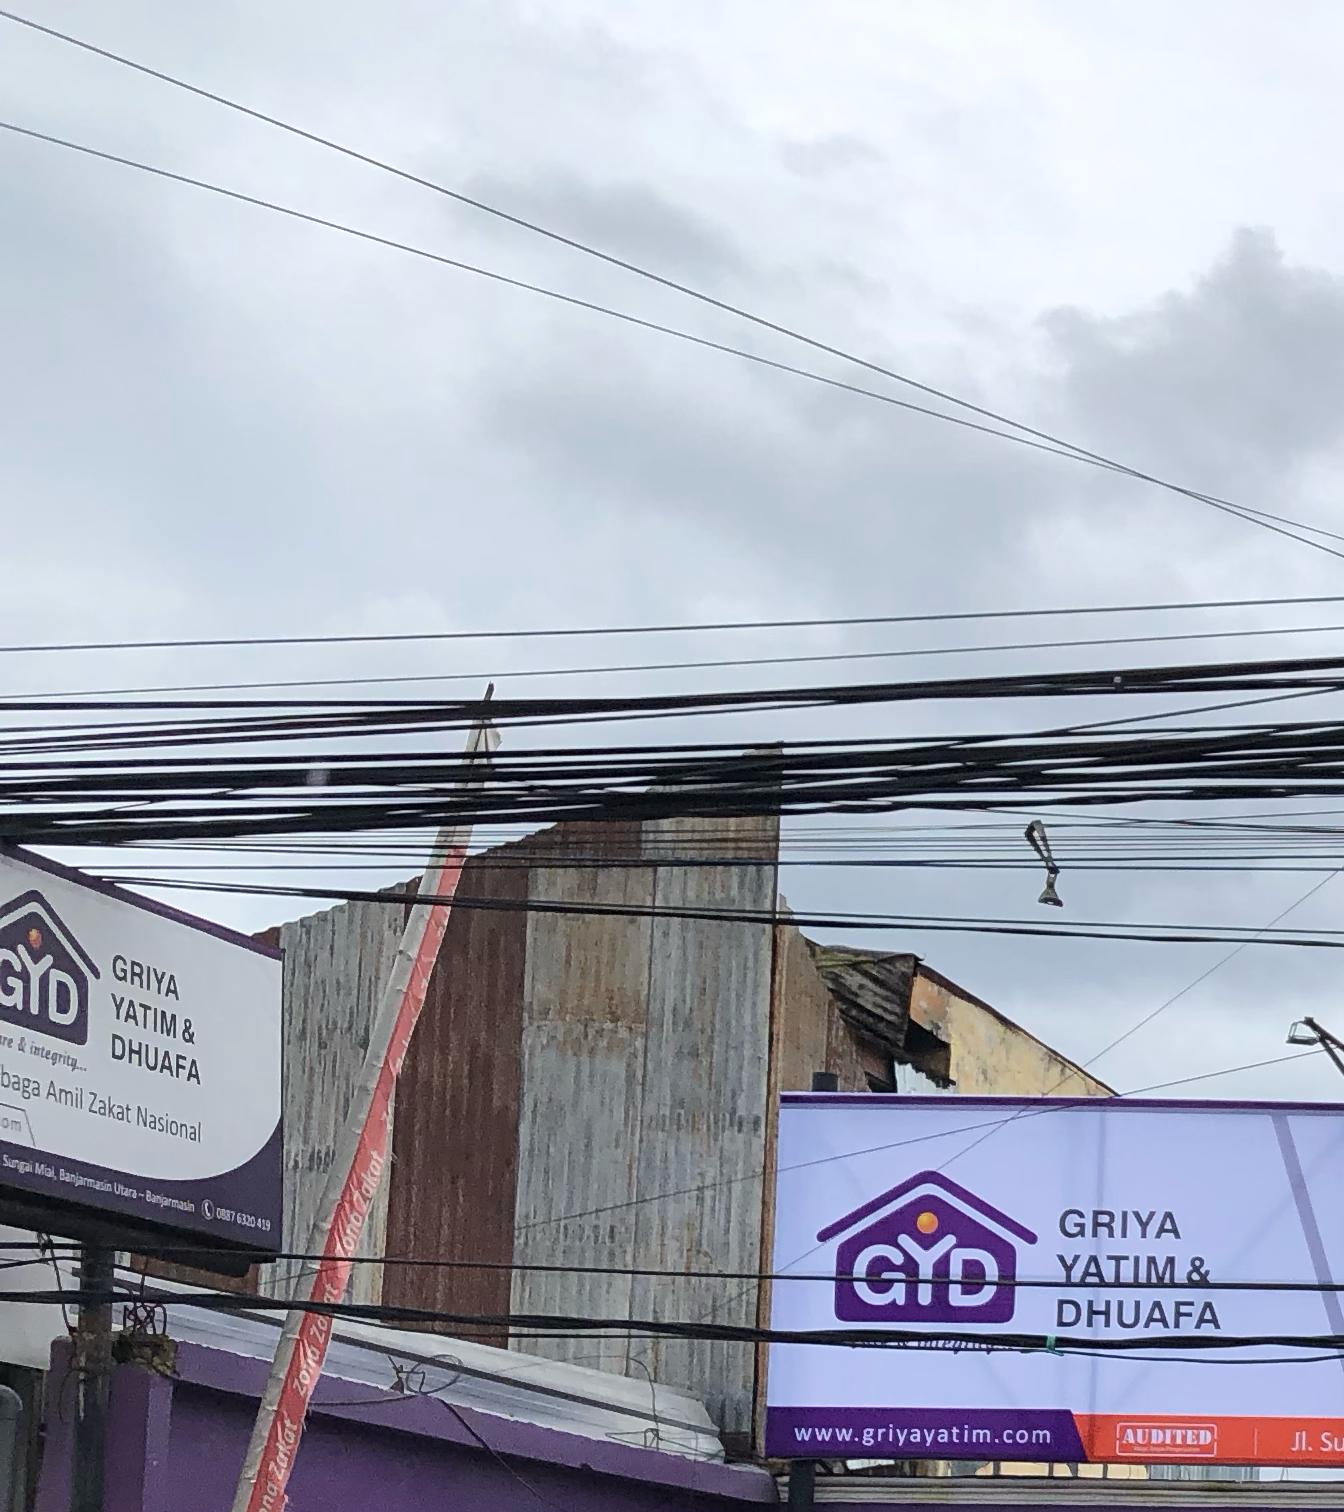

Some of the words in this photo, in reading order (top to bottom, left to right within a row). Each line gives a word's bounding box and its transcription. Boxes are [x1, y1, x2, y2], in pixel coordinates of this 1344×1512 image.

[0, 944, 79, 1025] GYD
[112, 954, 180, 1001] GRIYA
[110, 992, 177, 1039] YATIM
[181, 1018, 196, 1045] &
[17, 1036, 26, 1054] &
[111, 1033, 201, 1086] DHUAFA
[46, 1080, 84, 1110] Amil
[88, 1091, 132, 1124] Zakat
[136, 1105, 202, 1143] Nasional
[2, 1153, 33, 1174] Sungai
[60, 1168, 113, 1193] Banjarmasin
[113, 1181, 138, 1199] Utara
[145, 1189, 195, 1214] Banjarmasin
[256, 1218, 271, 1232] 419
[1058, 1209, 1181, 1240] GRIYA
[852, 1233, 999, 1307] GYD
[1056, 1254, 1177, 1286] YATIM
[1186, 1254, 1211, 1286] &
[1056, 1299, 1222, 1330] DHUAFA
[268, 1418, 299, 1482] Zakat
[794, 1423, 1051, 1448] www.griyayatim.com
[1121, 1428, 1213, 1446] AUDITED
[1290, 1432, 1312, 1453] Jl.
